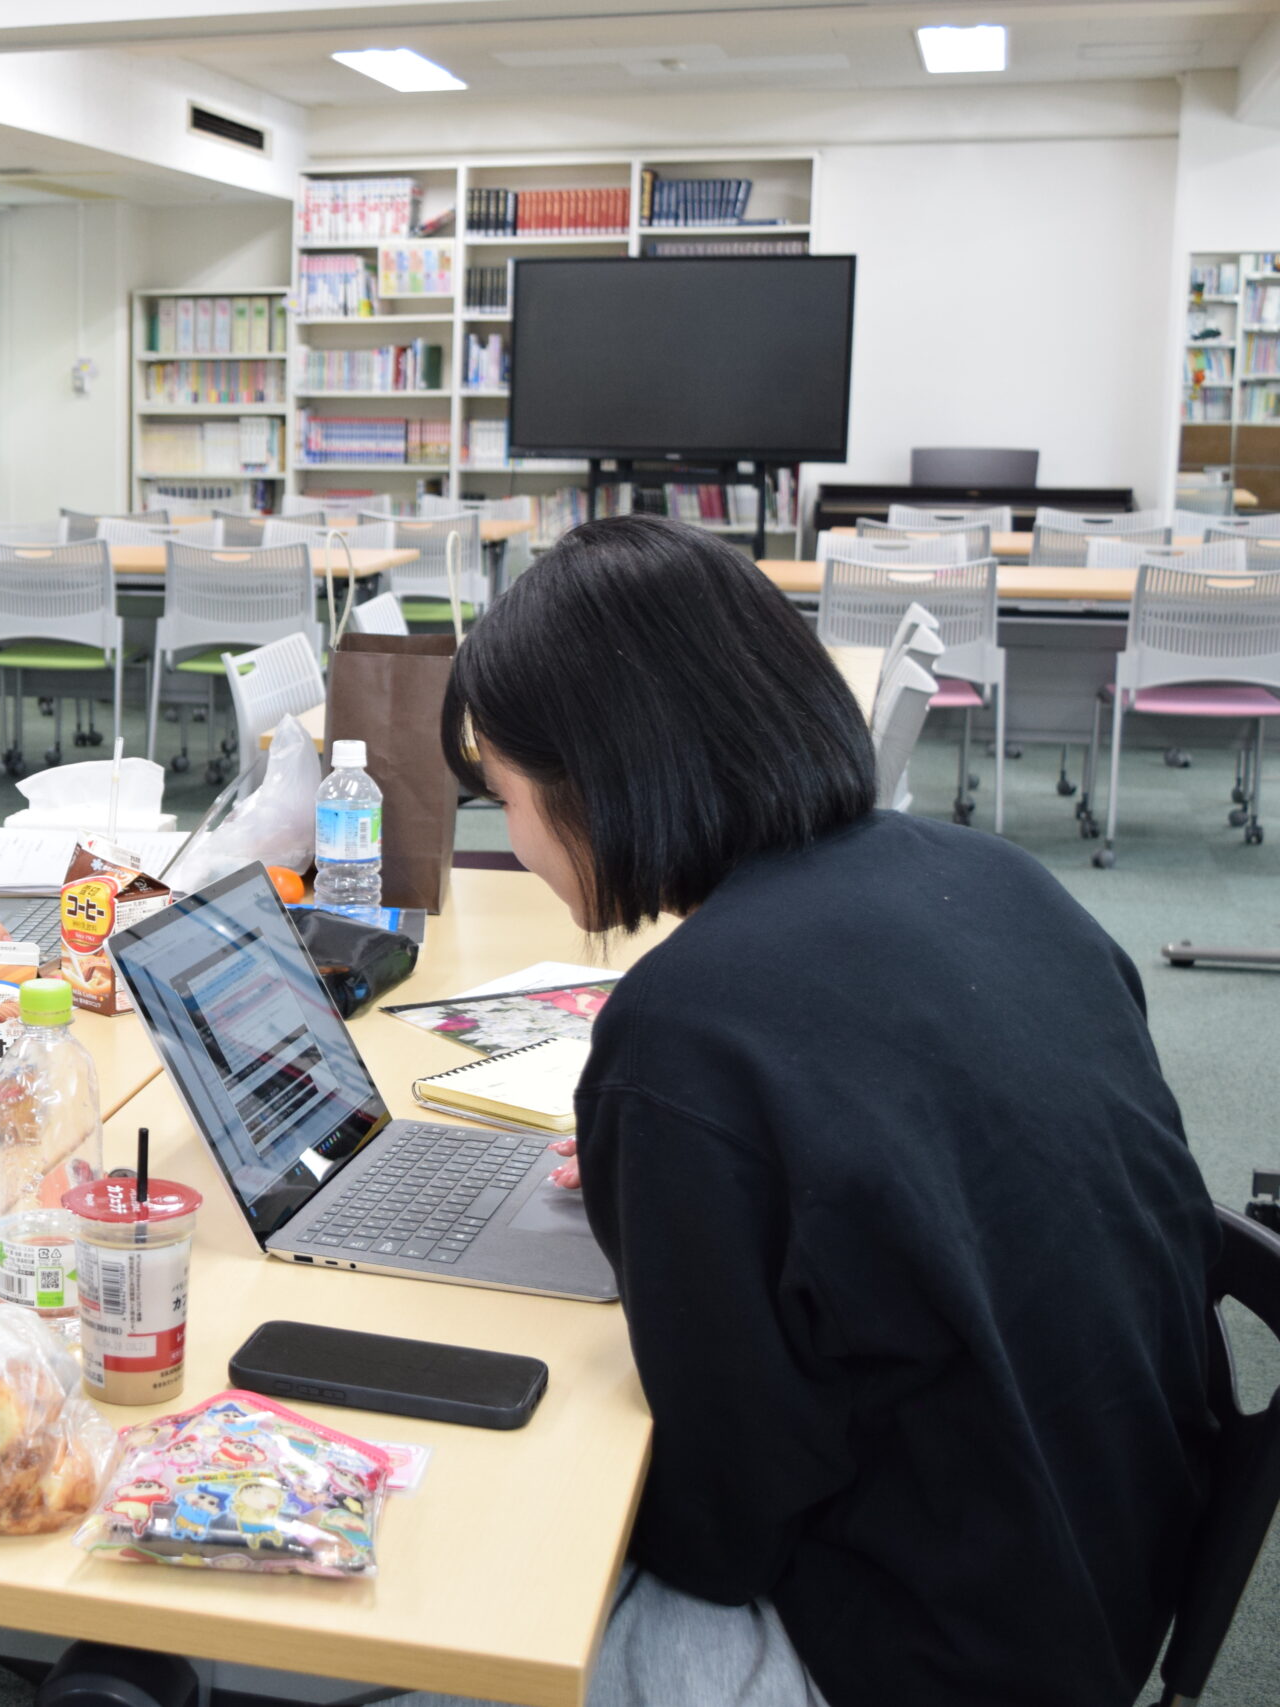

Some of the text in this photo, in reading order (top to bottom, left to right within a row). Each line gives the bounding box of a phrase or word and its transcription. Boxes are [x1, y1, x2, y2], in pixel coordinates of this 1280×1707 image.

[66, 894, 105, 922] コーヒー
[106, 1185, 128, 1214] カフェラテ
